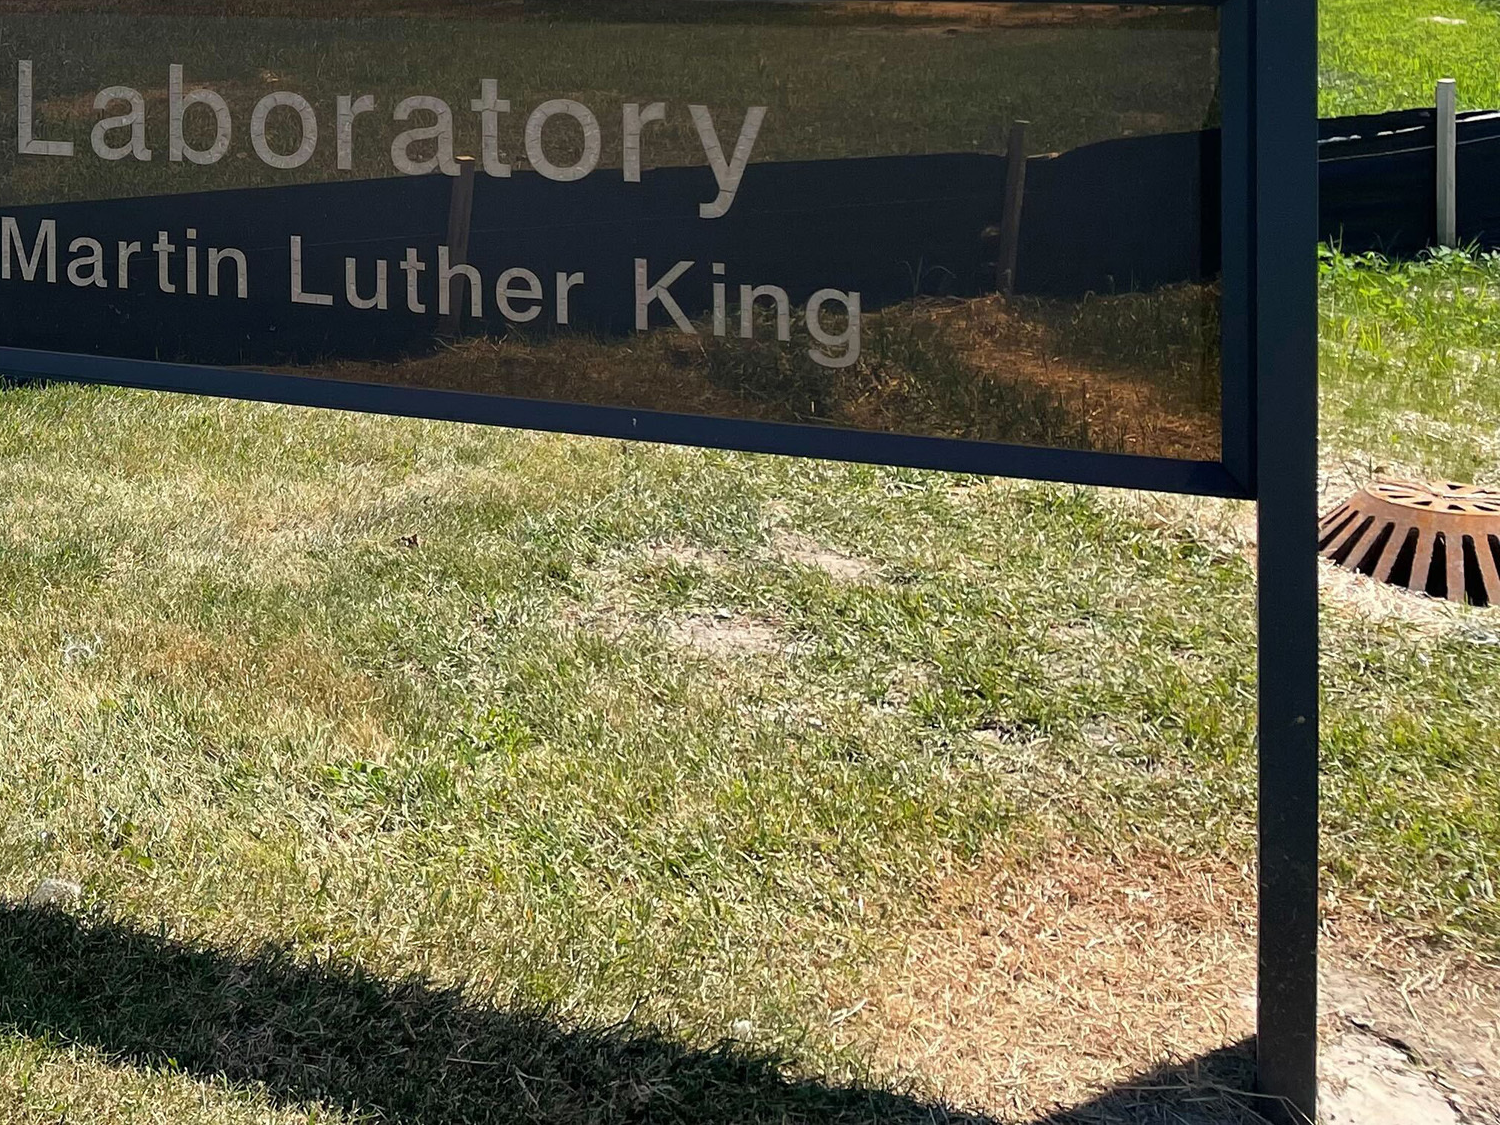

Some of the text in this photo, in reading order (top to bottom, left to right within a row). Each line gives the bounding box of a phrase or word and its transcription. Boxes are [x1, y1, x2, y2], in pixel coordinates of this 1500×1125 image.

[16, 59, 769, 219] Laboratory
[0, 216, 249, 300] Martin
[288, 234, 585, 326] Luther
[633, 257, 862, 369] King
